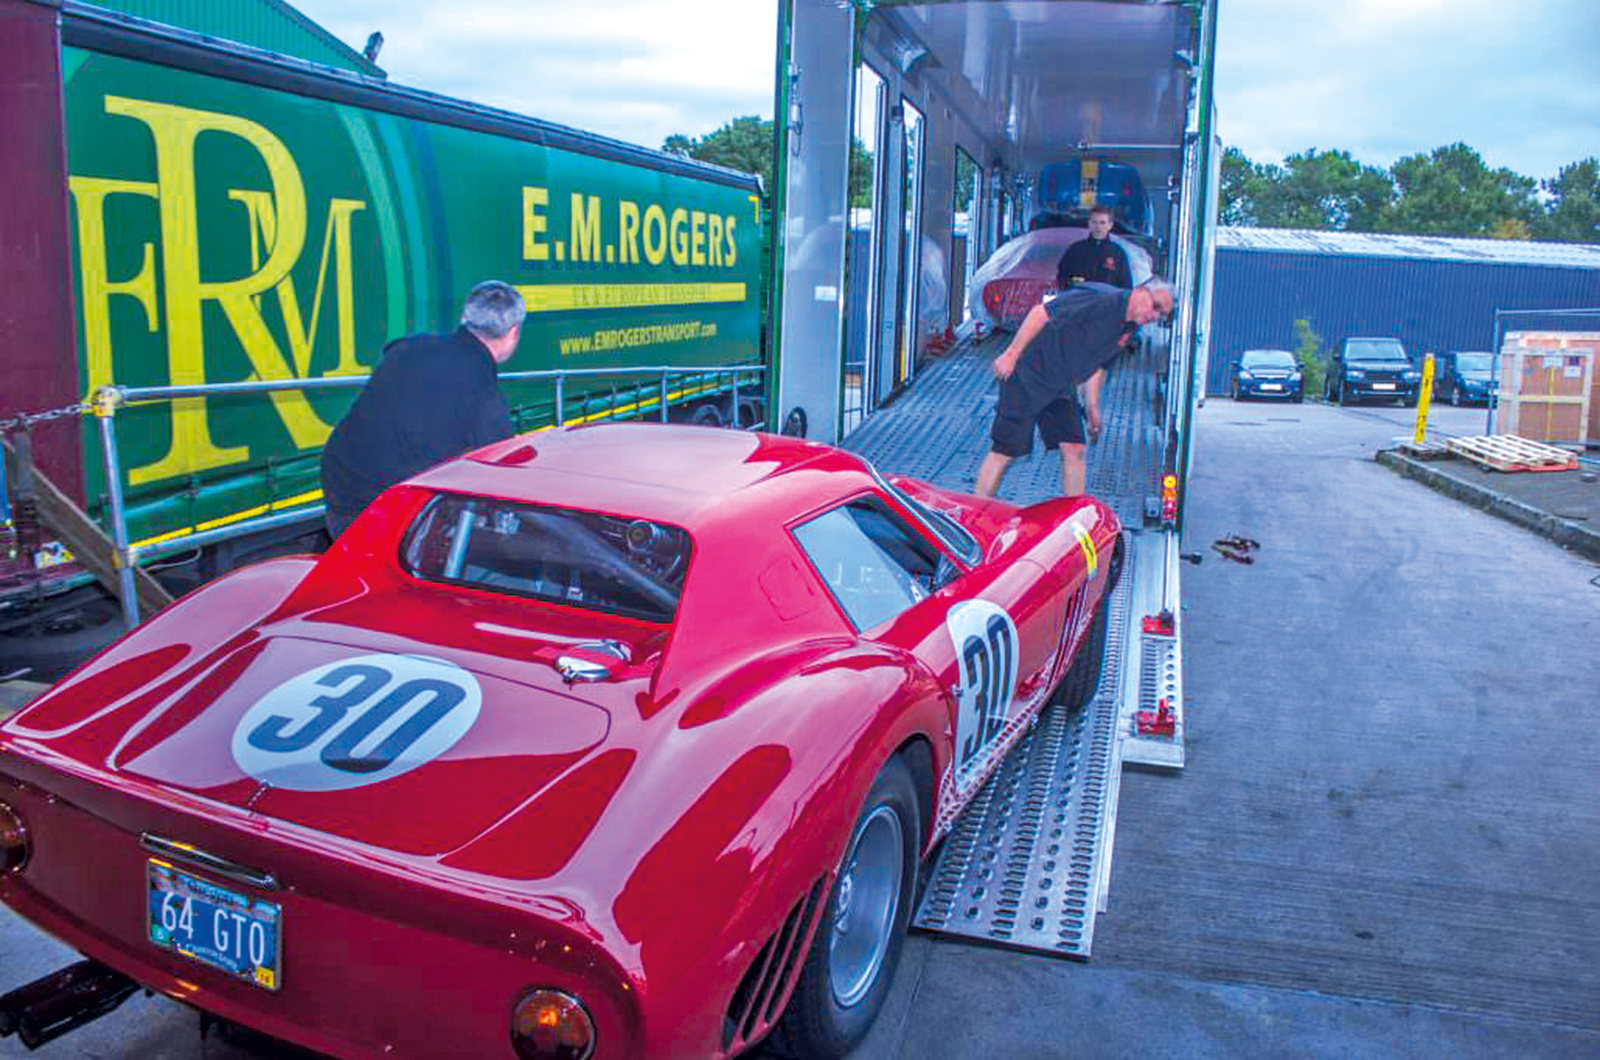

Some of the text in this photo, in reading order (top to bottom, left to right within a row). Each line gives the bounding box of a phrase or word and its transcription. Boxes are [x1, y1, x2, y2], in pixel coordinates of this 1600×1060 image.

[247, 664, 467, 774] 30
[962, 613, 1012, 764] 30
[162, 892, 194, 939] 64
[214, 909, 264, 965] GTO
